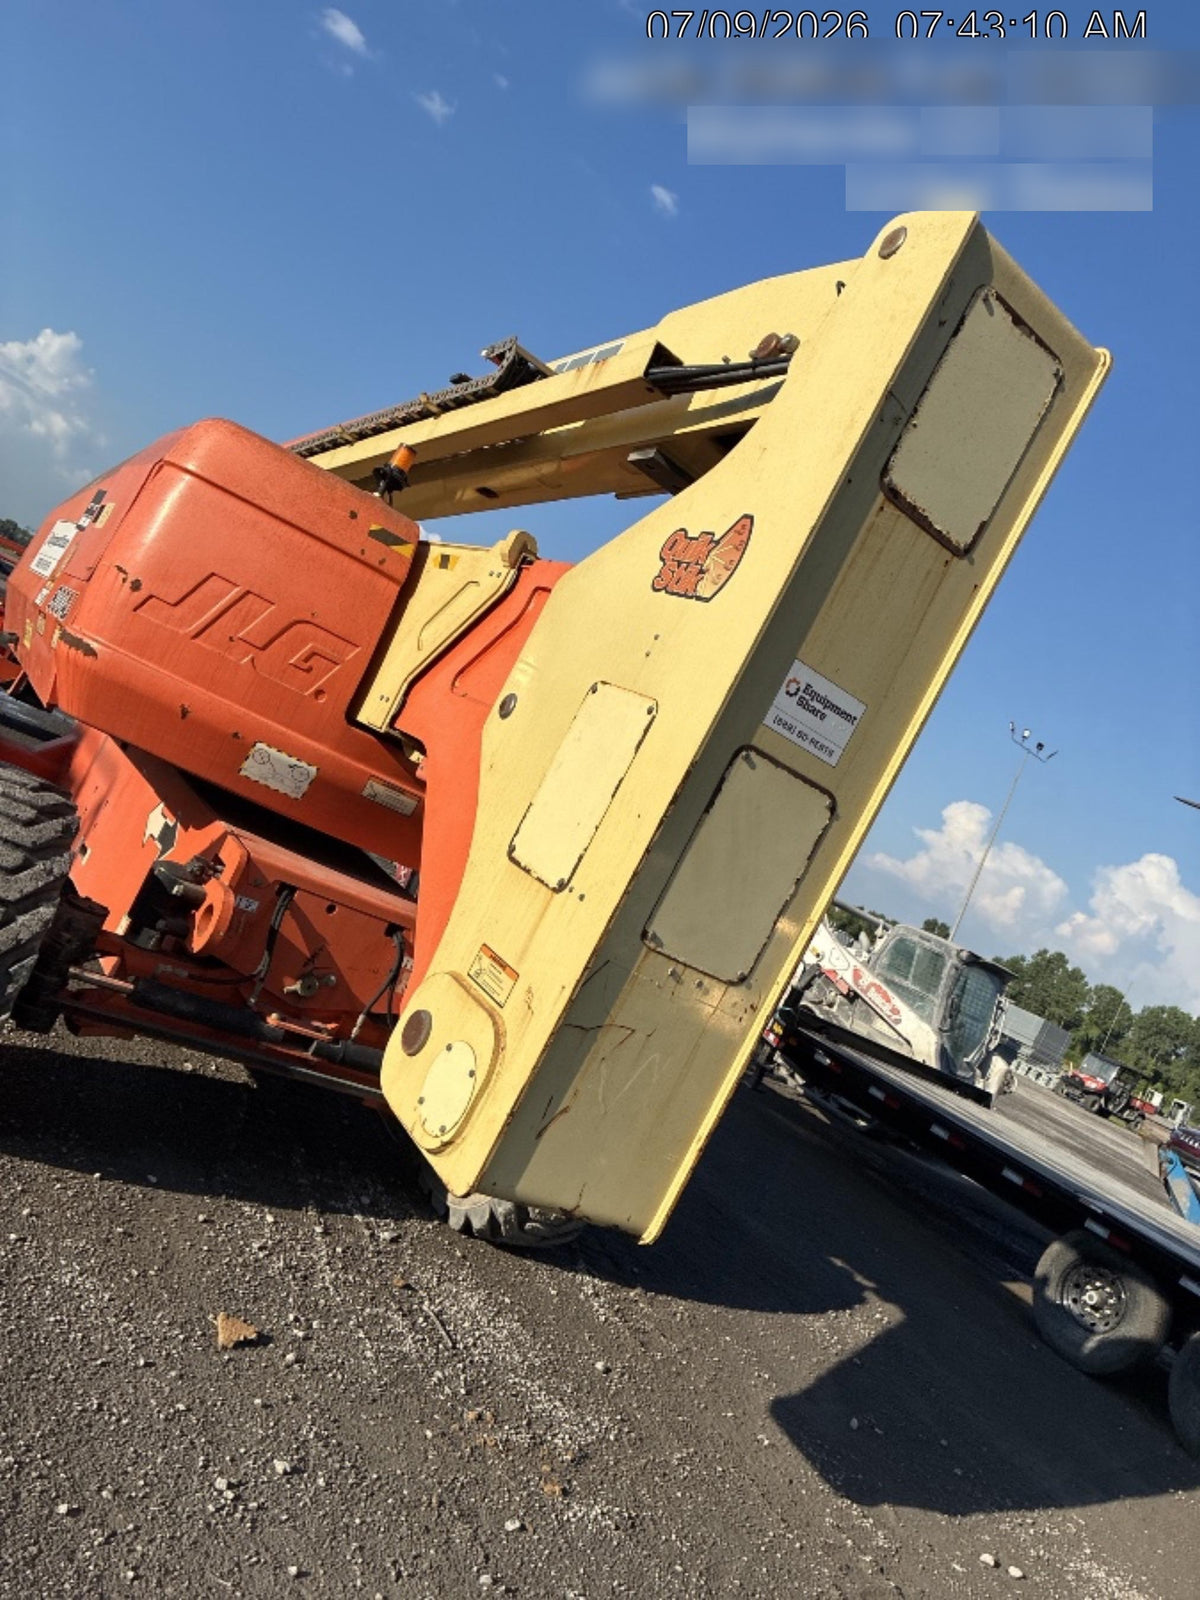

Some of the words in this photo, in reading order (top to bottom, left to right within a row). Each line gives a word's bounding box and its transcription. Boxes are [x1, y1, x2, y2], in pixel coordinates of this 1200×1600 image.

[133, 572, 362, 697] JLG
[795, 694, 828, 722] Share
[801, 682, 858, 727] Equipment
